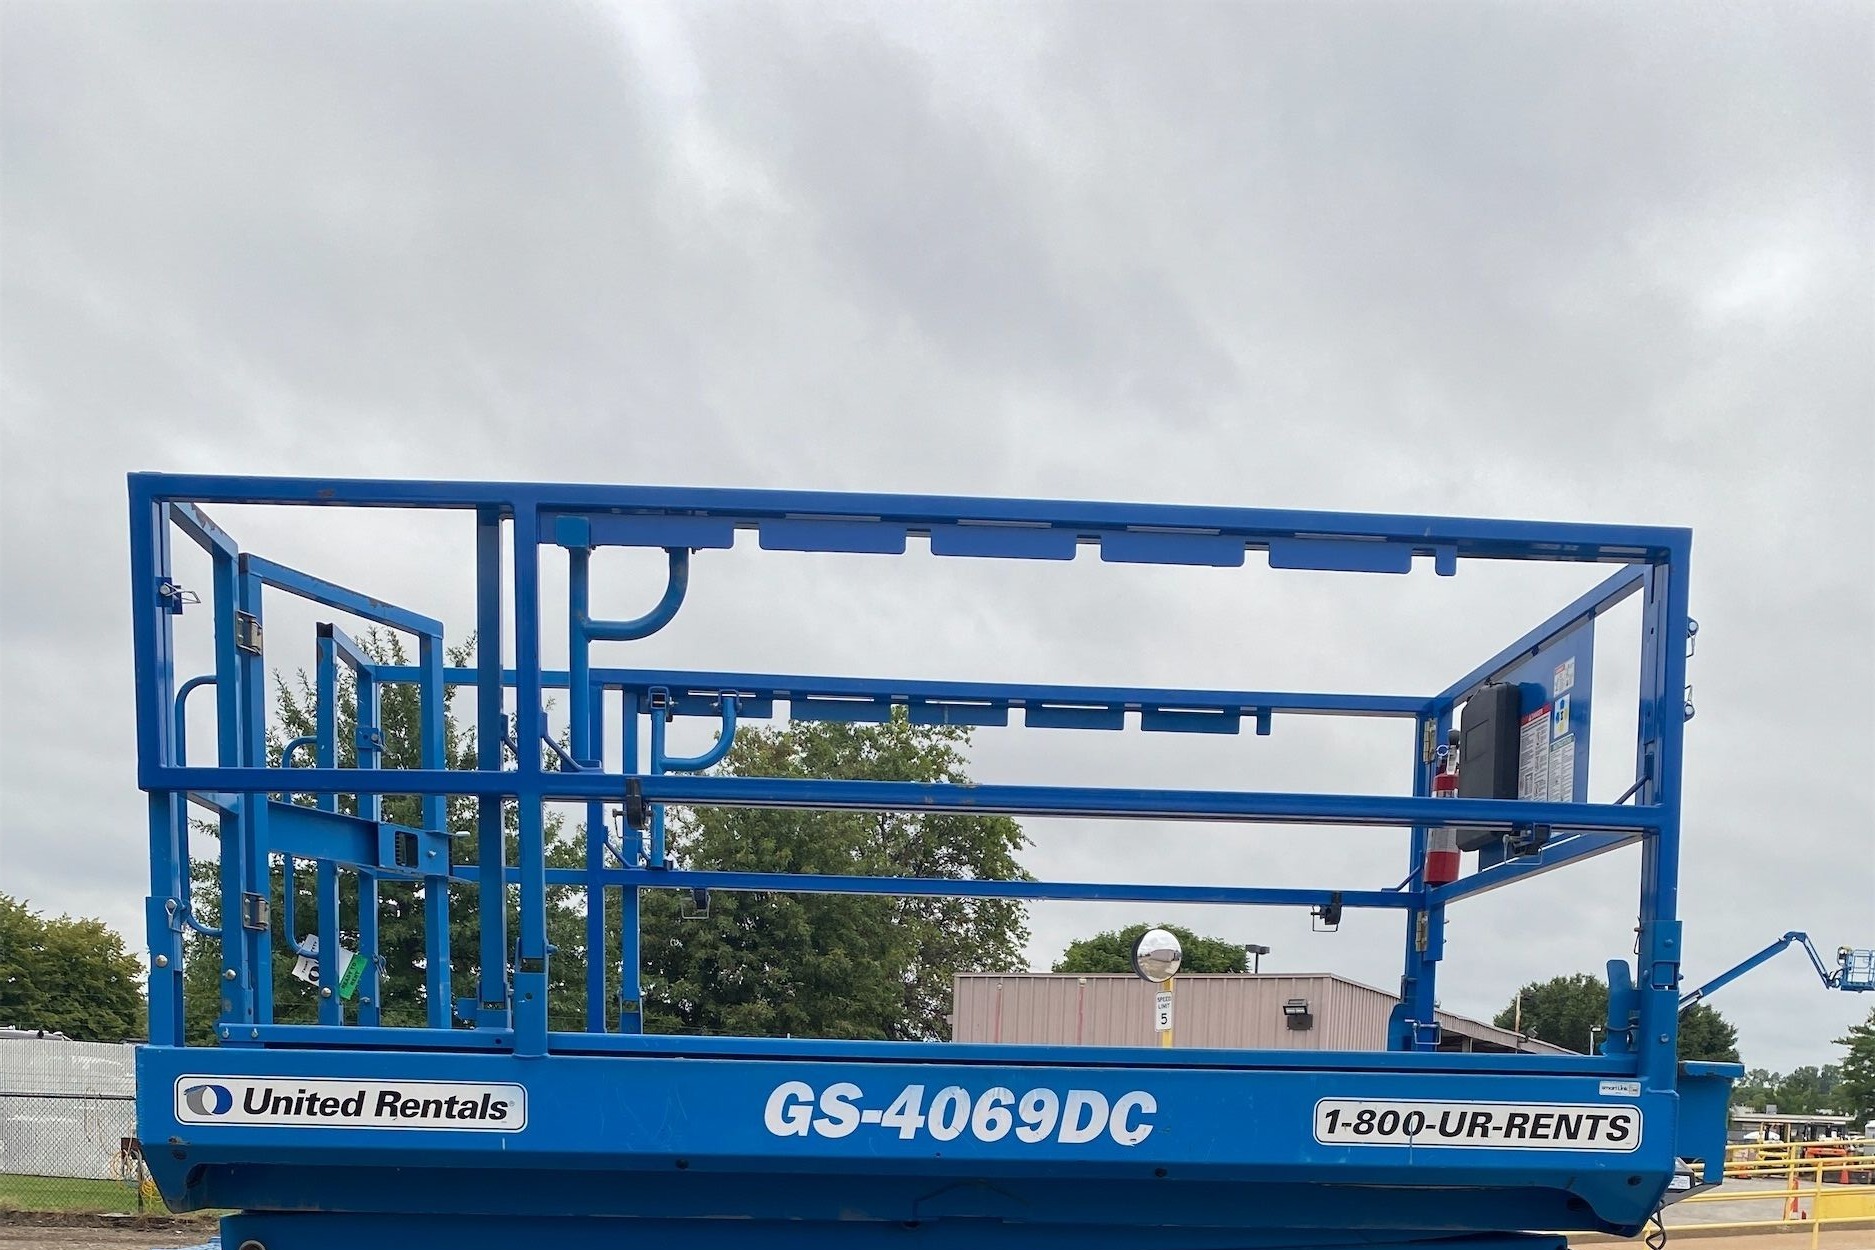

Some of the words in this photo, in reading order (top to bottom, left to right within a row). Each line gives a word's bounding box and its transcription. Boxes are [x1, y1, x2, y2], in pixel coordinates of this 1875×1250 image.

[1161, 1012, 1168, 1025] 5
[243, 1087, 366, 1118] United
[374, 1090, 508, 1121] Rentals
[764, 1080, 1157, 1147] GS-4069DC
[1324, 1108, 1631, 1142] 1-800-UR-RENTS
